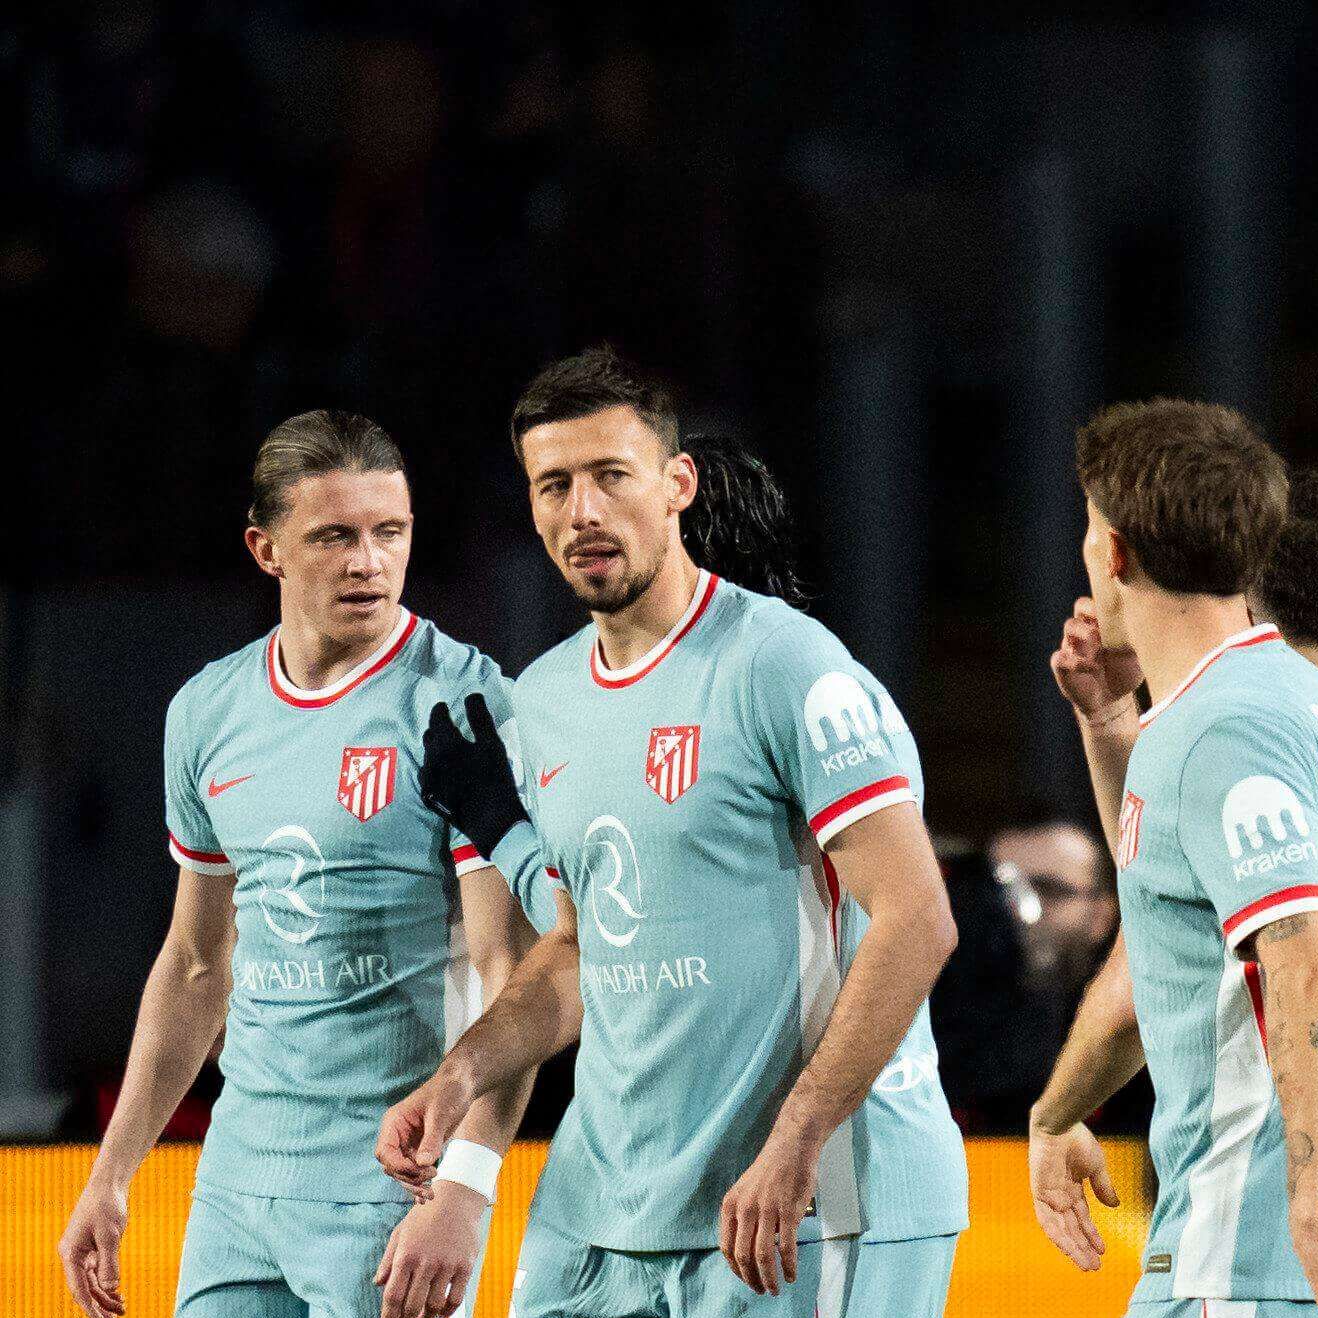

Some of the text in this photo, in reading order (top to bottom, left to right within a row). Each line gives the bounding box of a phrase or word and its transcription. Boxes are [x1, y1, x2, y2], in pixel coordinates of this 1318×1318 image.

[1233, 842, 1318, 882] kraken
[334, 954, 390, 987] AIR
[655, 956, 713, 993] AIR
